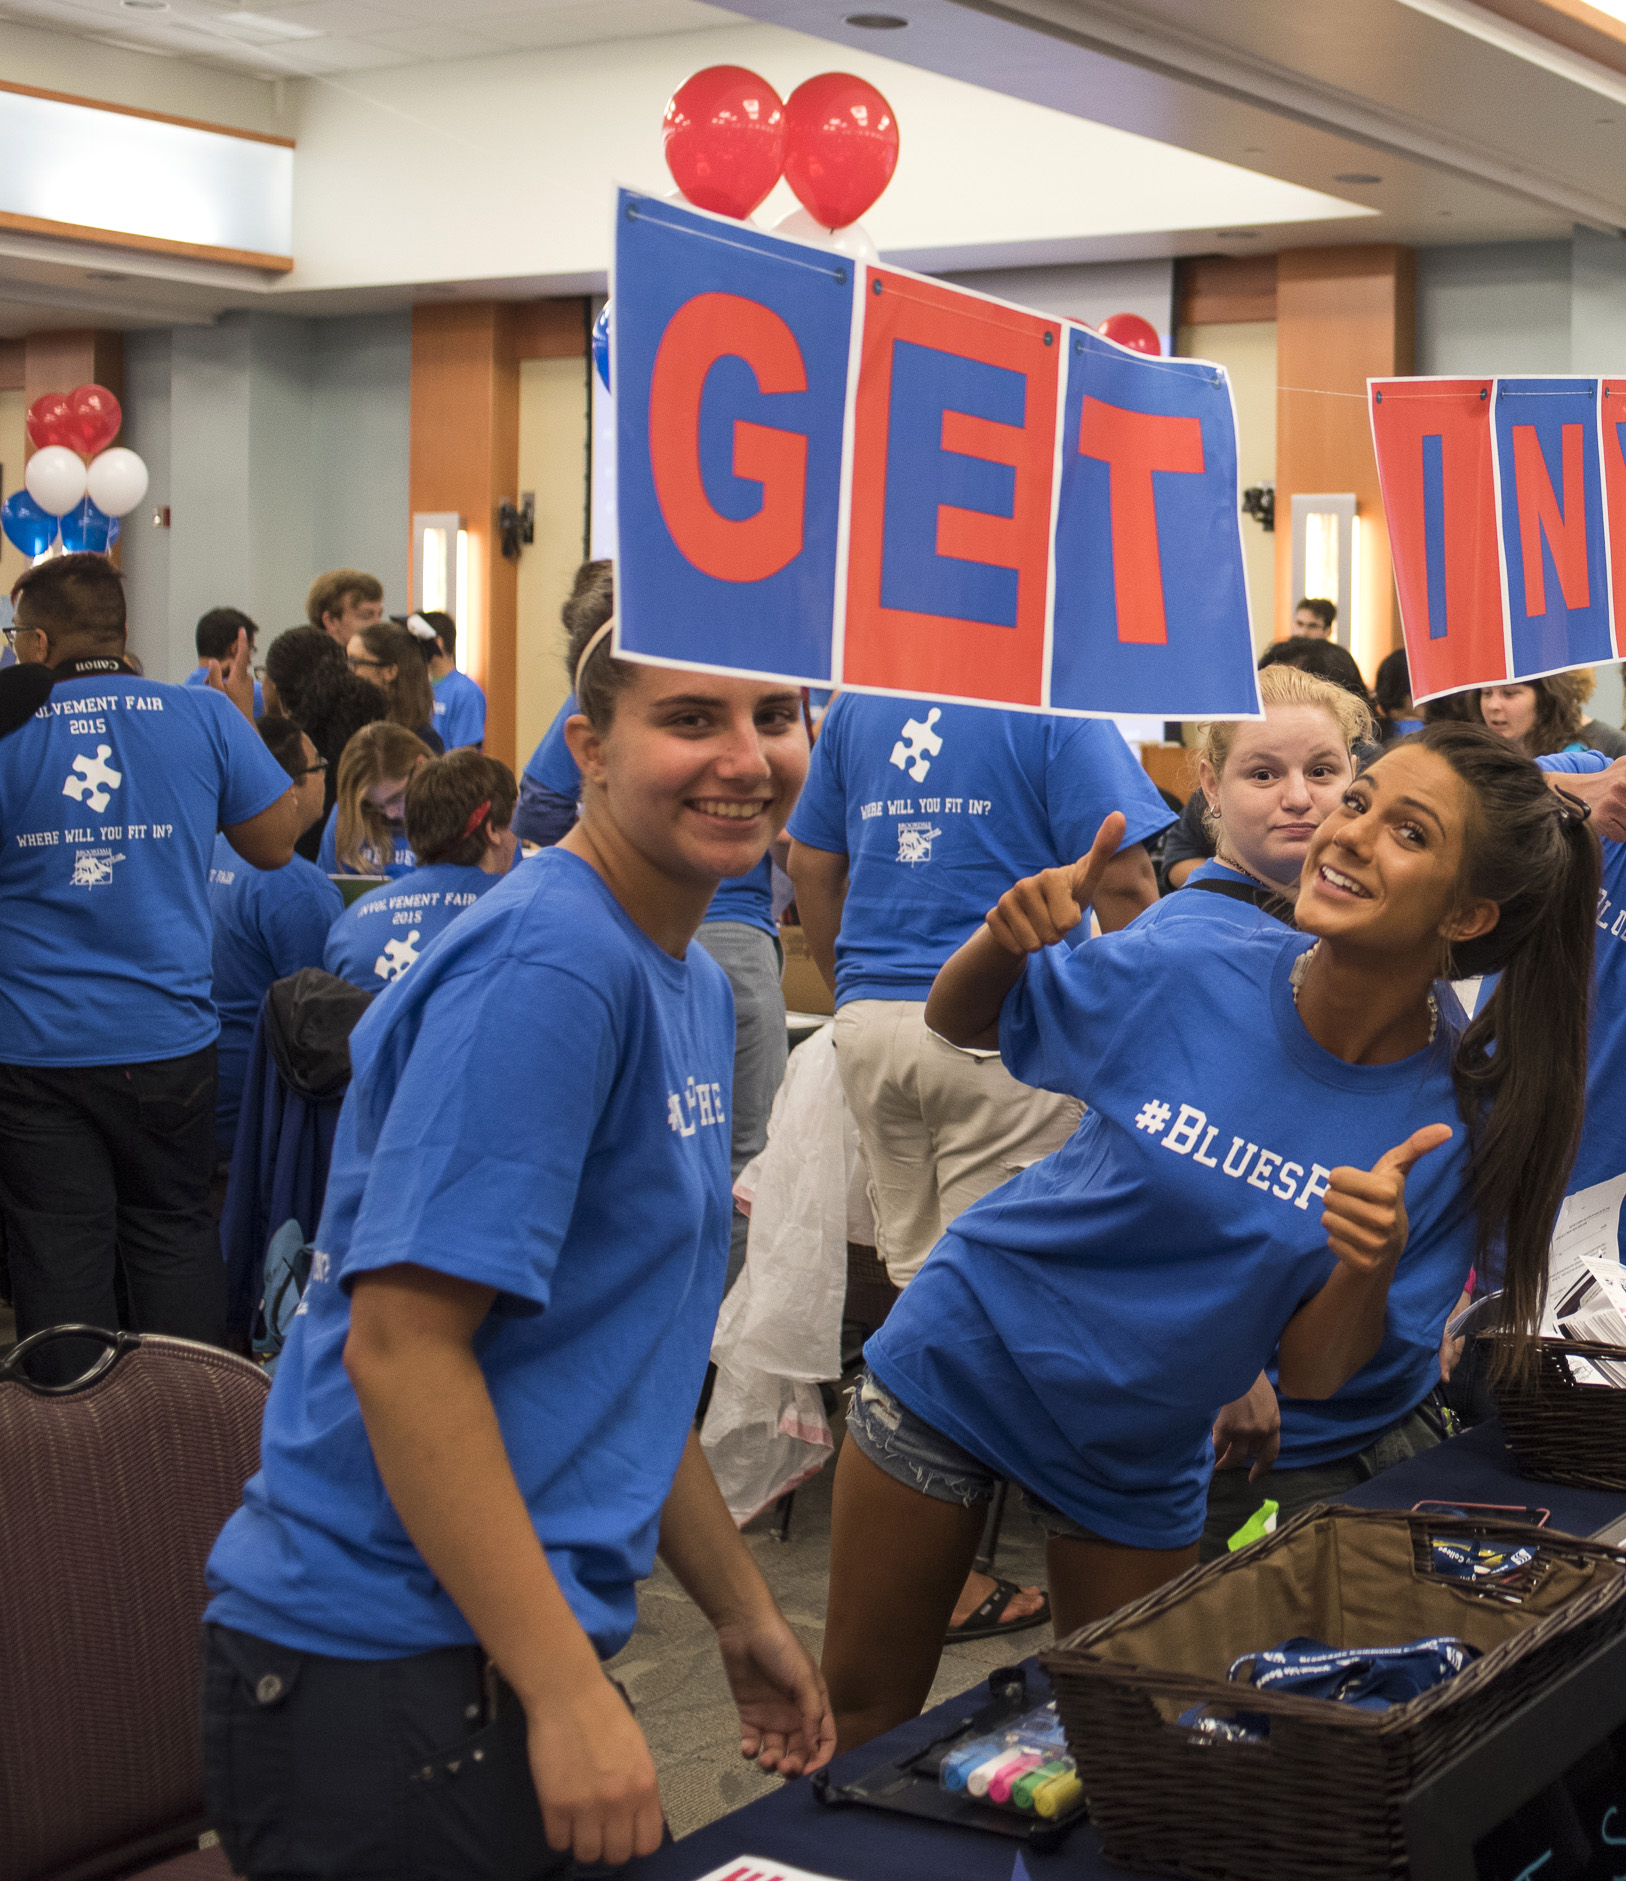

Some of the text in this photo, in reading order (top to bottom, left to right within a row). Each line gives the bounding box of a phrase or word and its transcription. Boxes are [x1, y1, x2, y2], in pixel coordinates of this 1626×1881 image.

[648, 290, 1206, 647] GET
[75, 659, 119, 672] Canon
[125, 696, 164, 712] FAIR
[70, 718, 107, 735] 2015
[887, 799, 914, 815] WILL
[919, 798, 941, 814] YOU
[945, 798, 963, 813] FIT
[968, 799, 992, 816] IN?
[16, 824, 173, 848] WHERE WILL YOU FIT IN?
[392, 910, 423, 925] 2015
